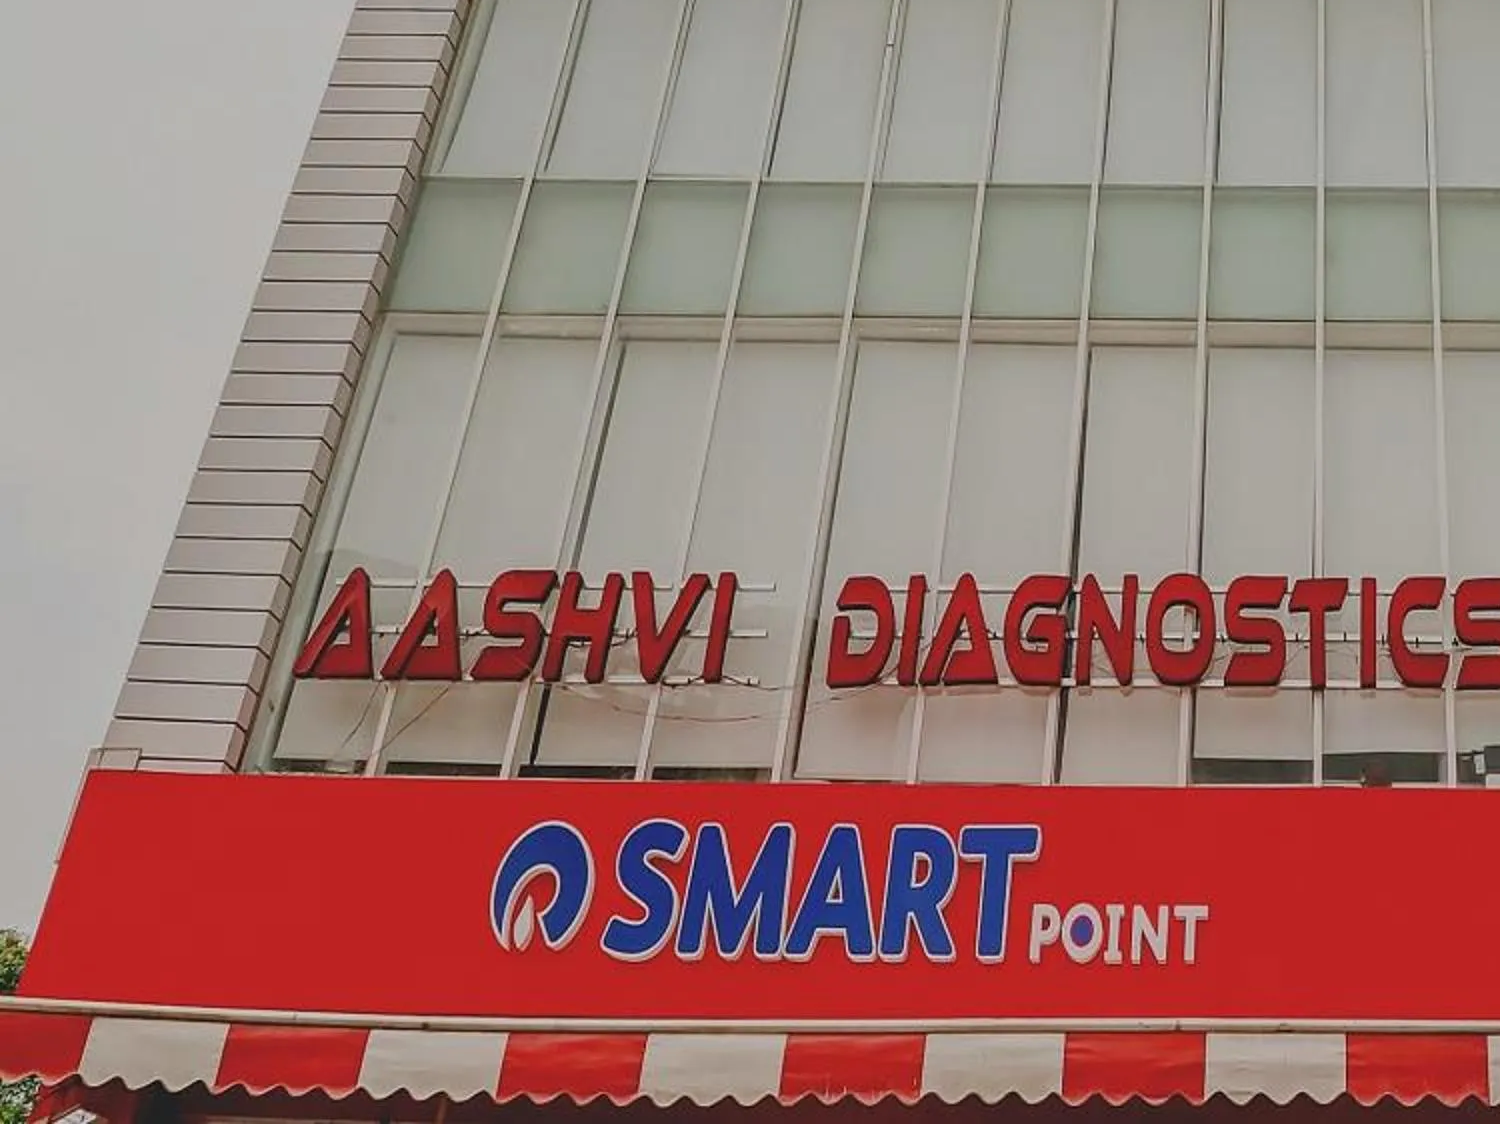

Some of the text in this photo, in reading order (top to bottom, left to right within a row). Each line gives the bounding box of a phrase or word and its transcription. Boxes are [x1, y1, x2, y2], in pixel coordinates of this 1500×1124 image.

[293, 566, 738, 683] AASHVI
[602, 818, 1210, 965] SMART POINT
